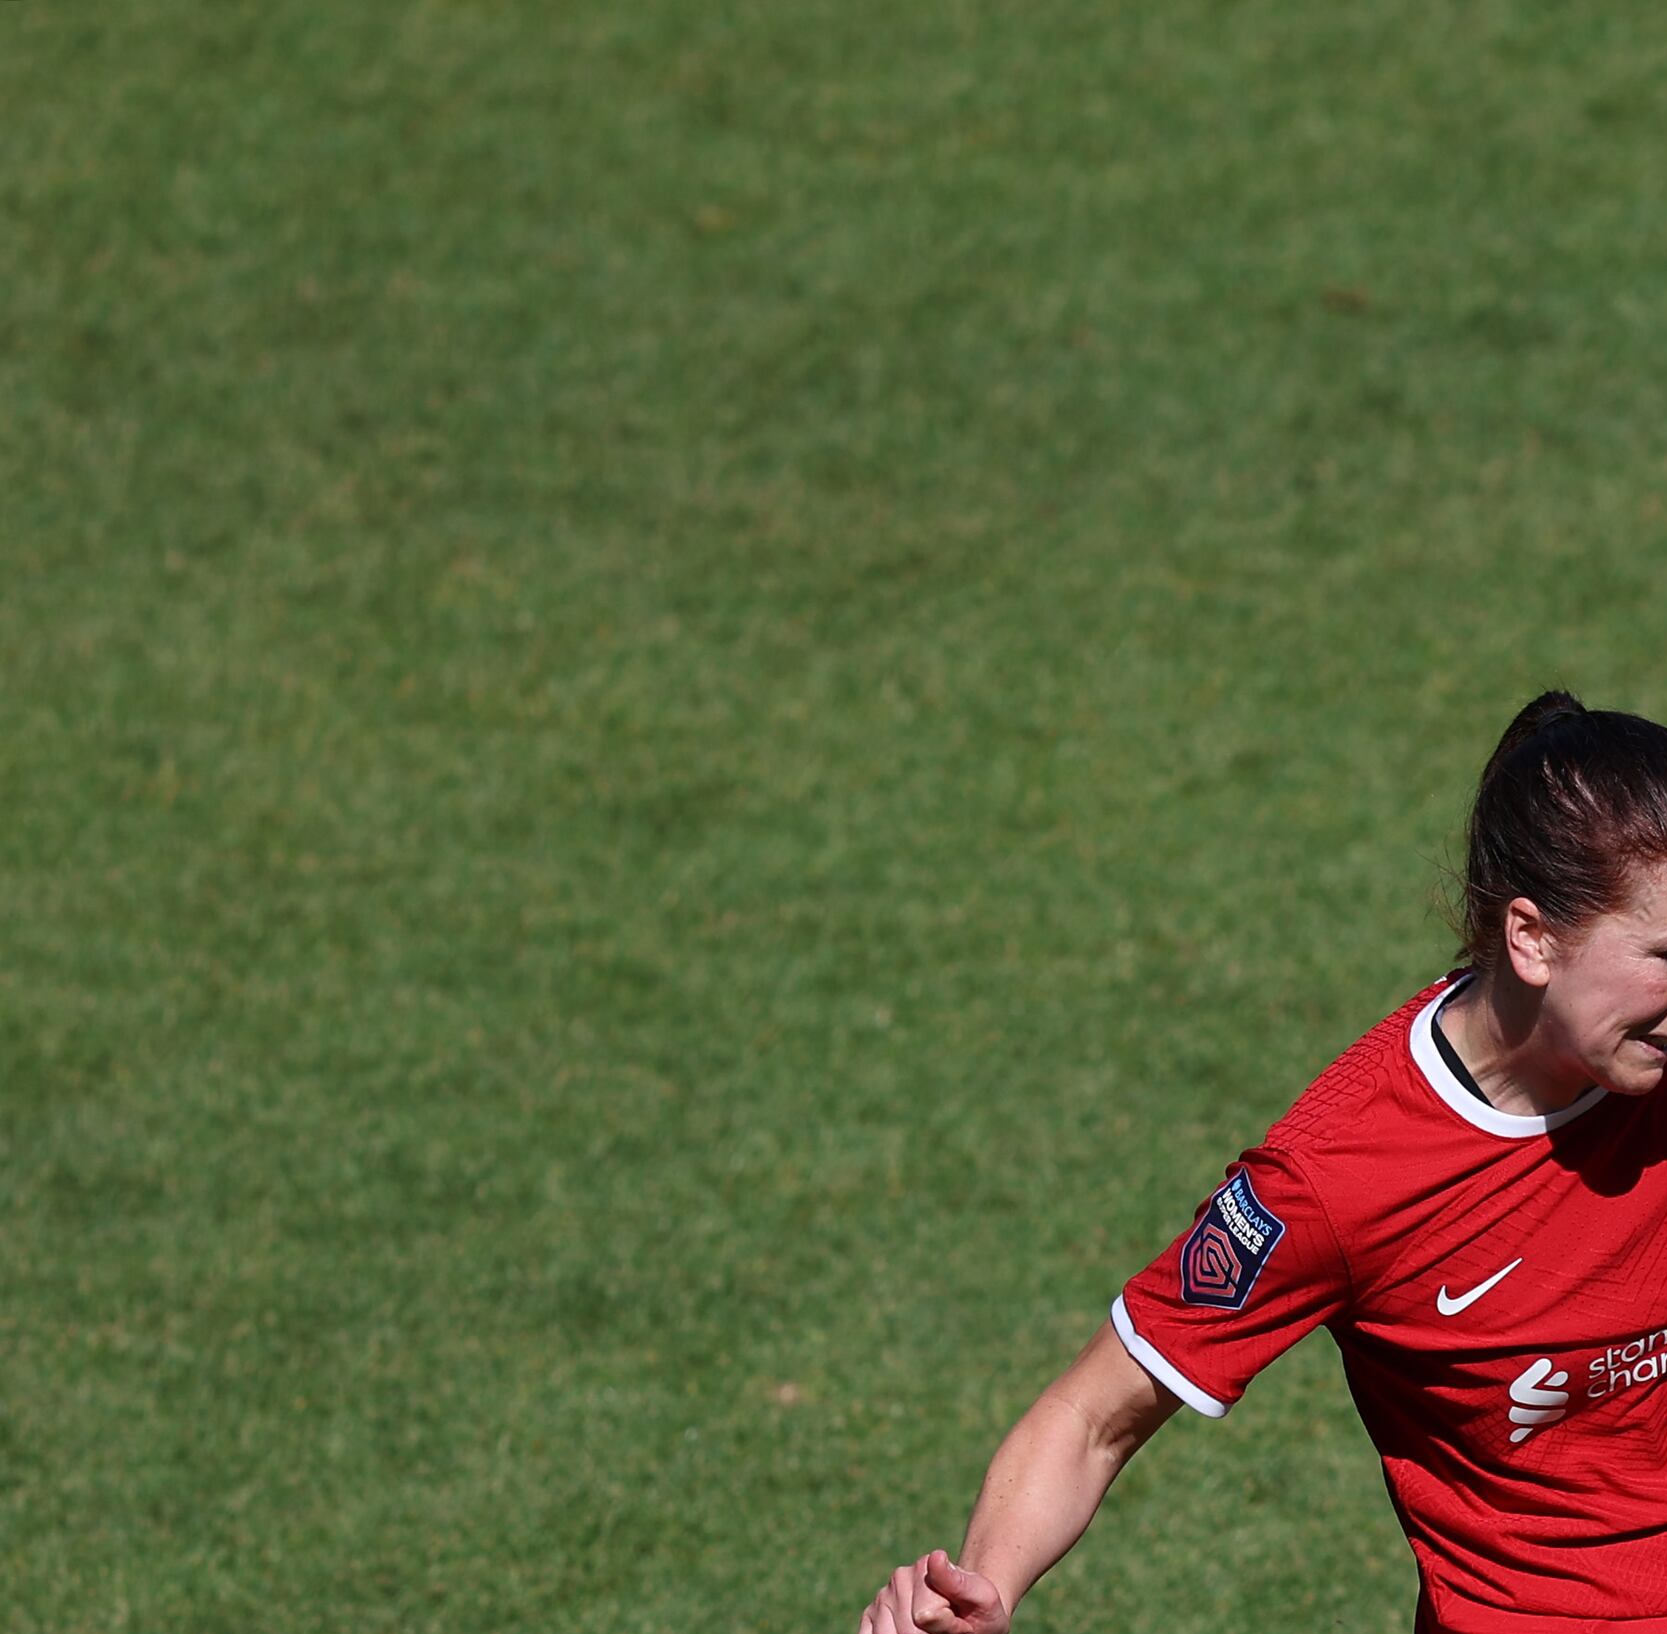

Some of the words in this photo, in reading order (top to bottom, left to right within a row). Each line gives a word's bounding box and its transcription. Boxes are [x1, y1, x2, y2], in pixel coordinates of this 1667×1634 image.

[1222, 1187, 1265, 1248] WOMEN'S
[1234, 1188, 1273, 1236] BARCLAYS
[1228, 1221, 1260, 1256] LEAGUE
